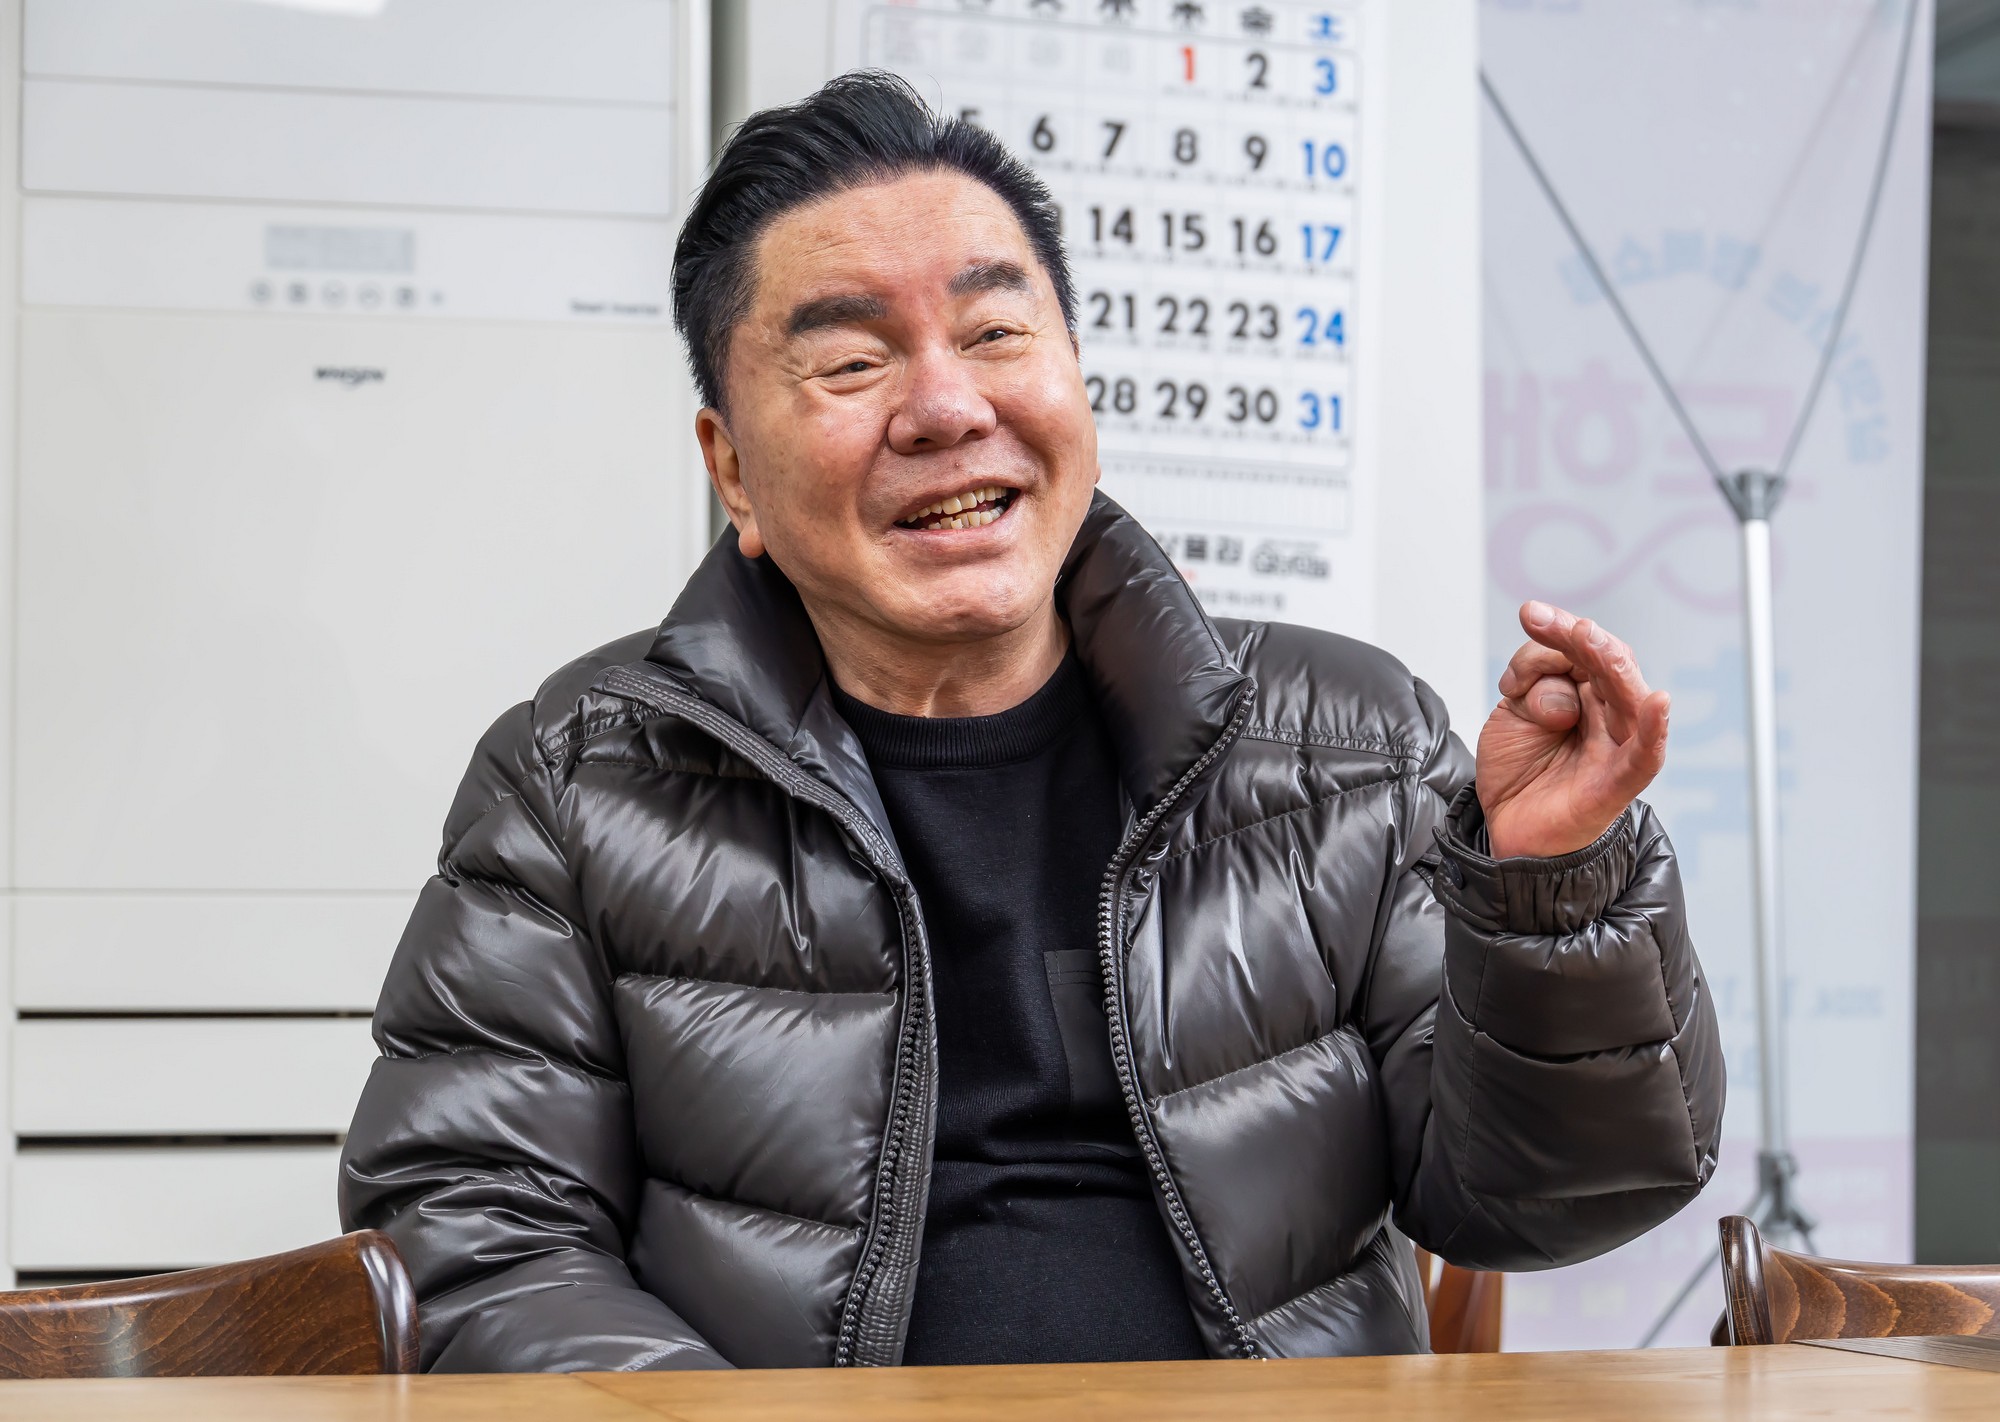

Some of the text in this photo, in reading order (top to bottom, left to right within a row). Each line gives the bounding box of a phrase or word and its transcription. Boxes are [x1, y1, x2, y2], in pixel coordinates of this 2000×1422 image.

[1182, 46, 1194, 81] 1
[1246, 50, 1268, 90] 2
[1315, 57, 1337, 96] 3
[1031, 115, 1055, 153] 6
[1103, 121, 1126, 159] 7
[1172, 128, 1198, 166] 8
[1244, 135, 1268, 171] 9
[1303, 140, 1346, 180] 10
[1090, 206, 1134, 245] 14
[1161, 212, 1206, 252] 15
[1232, 218, 1277, 257] 16
[1301, 224, 1342, 262] 17
[1088, 291, 1344, 345] 21 22 23 24
[1085, 375, 1341, 431] 28 29 30 31
